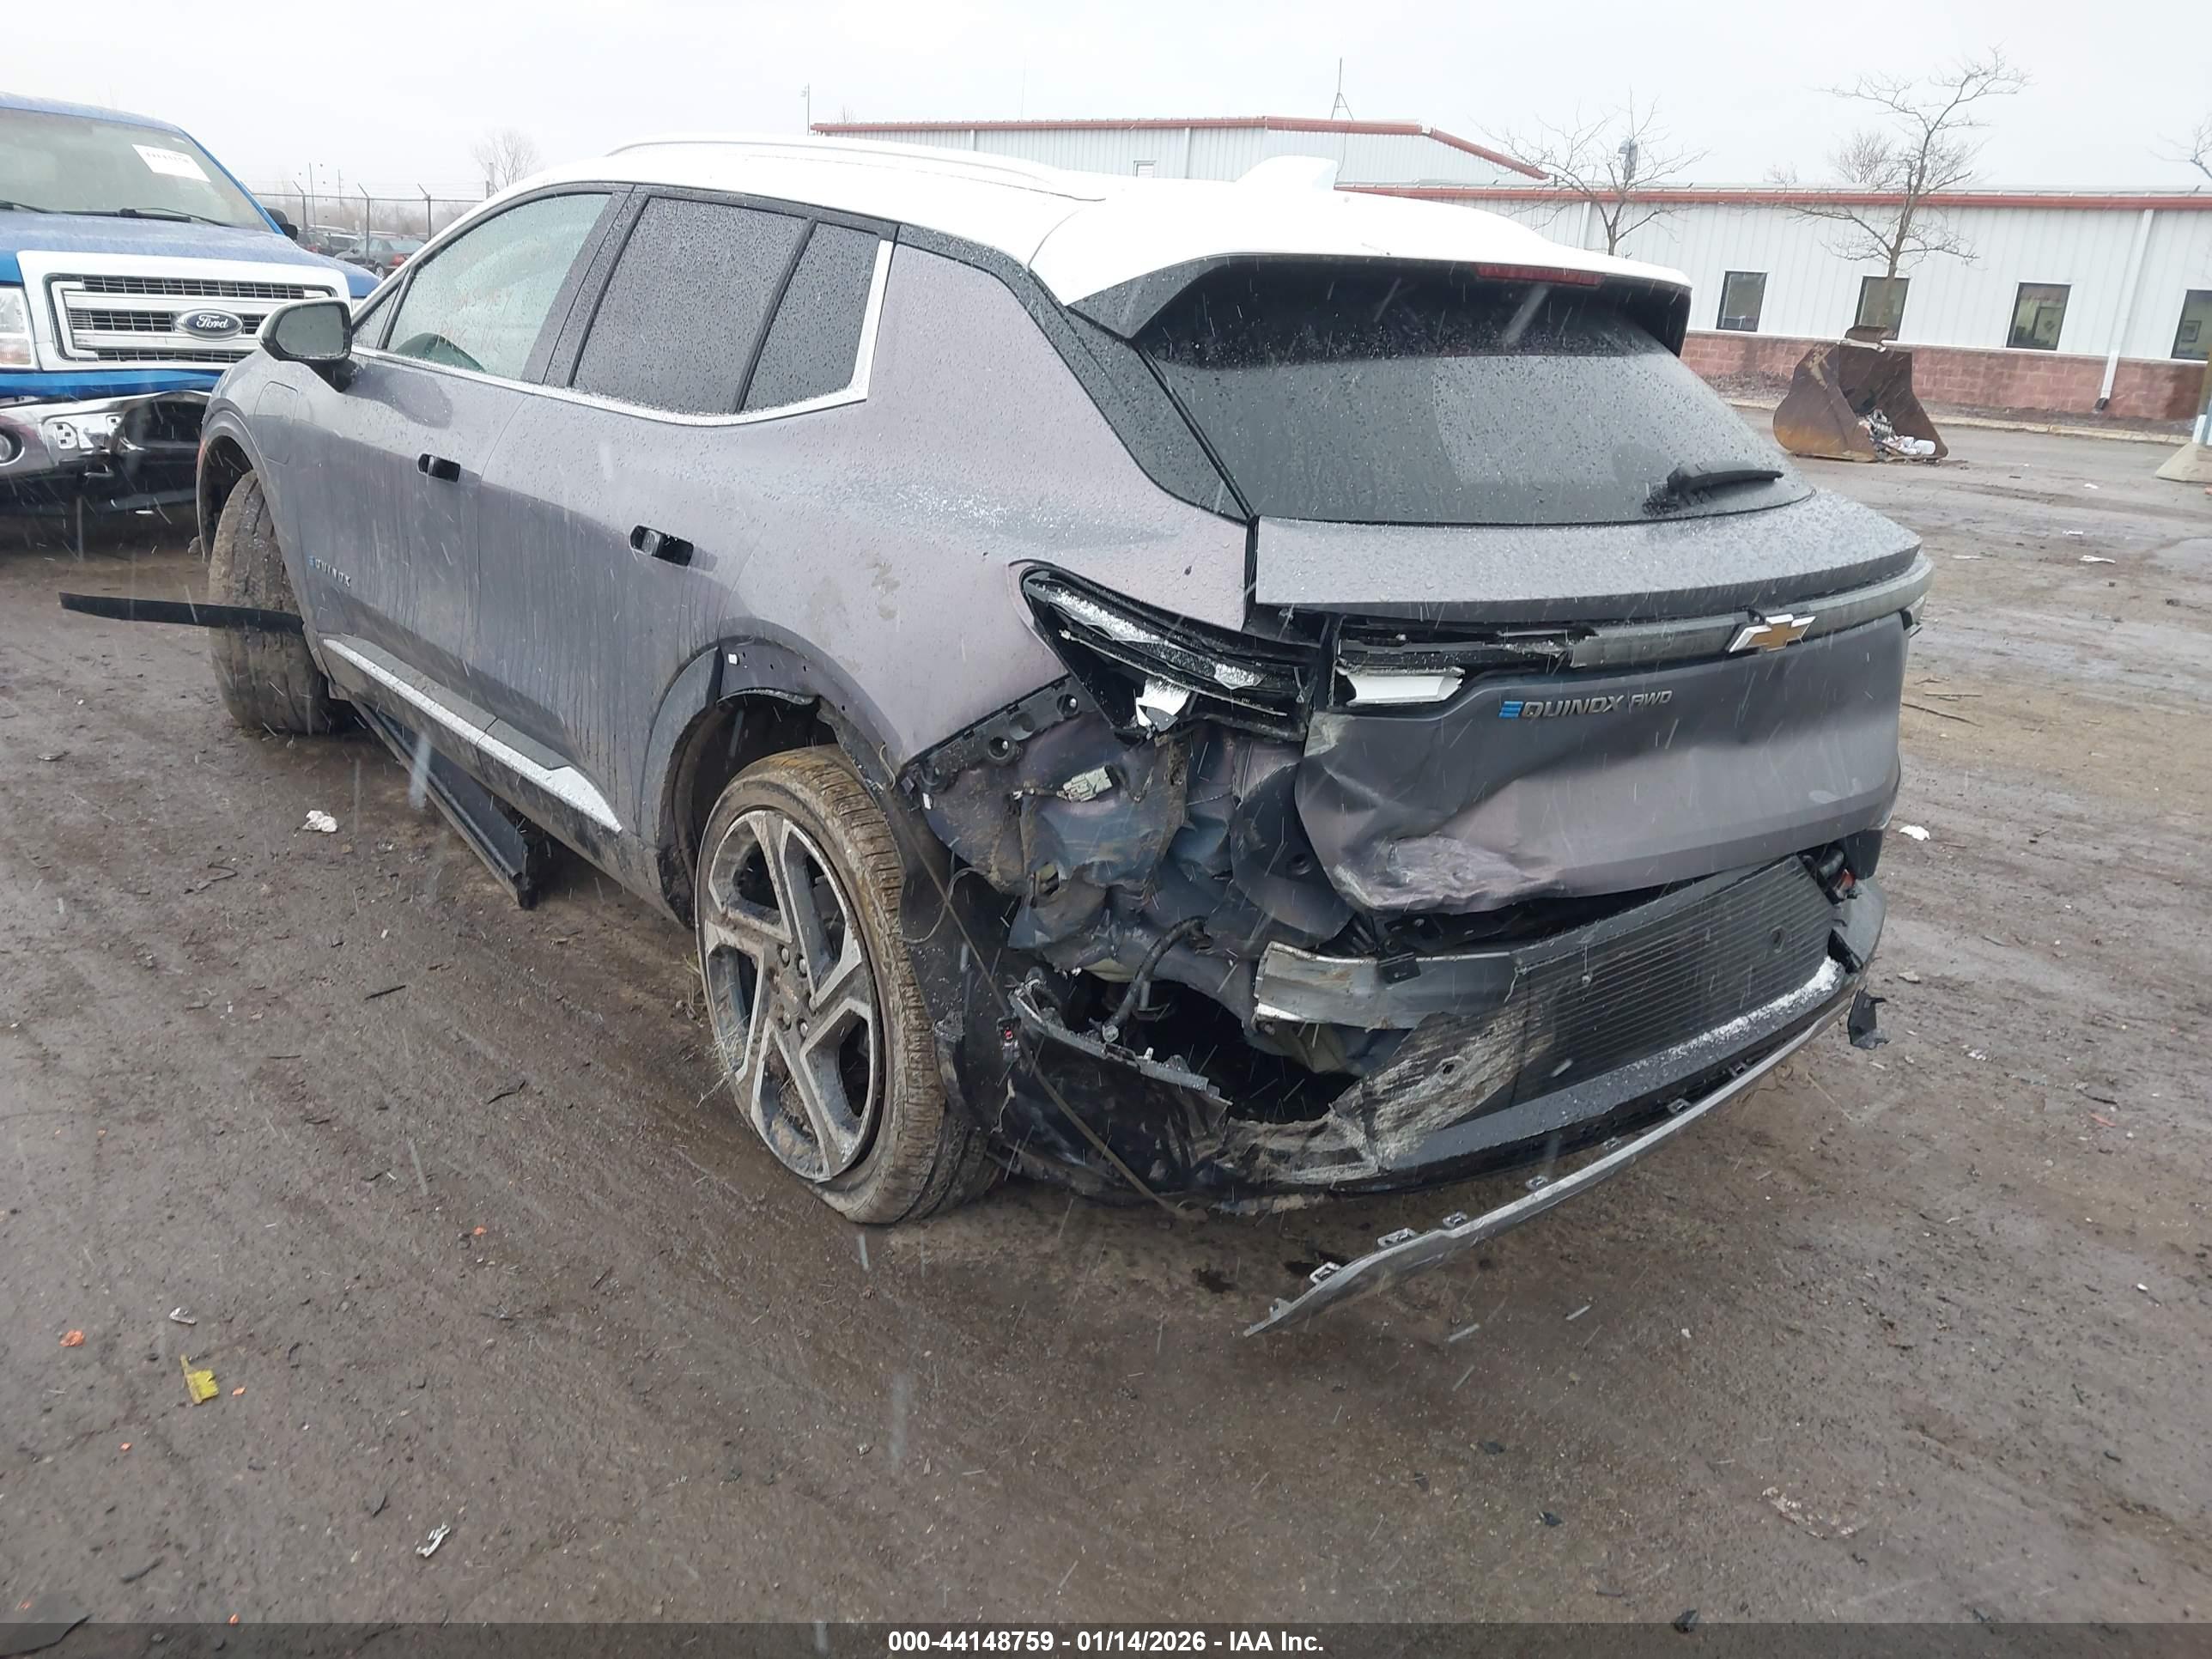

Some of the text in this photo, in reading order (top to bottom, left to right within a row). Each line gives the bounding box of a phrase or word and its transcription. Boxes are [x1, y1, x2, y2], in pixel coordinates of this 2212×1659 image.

[196, 314, 229, 329] Ford
[308, 556, 351, 587] EQUINOX
[1498, 690, 1673, 719] EQUINOX AWD
